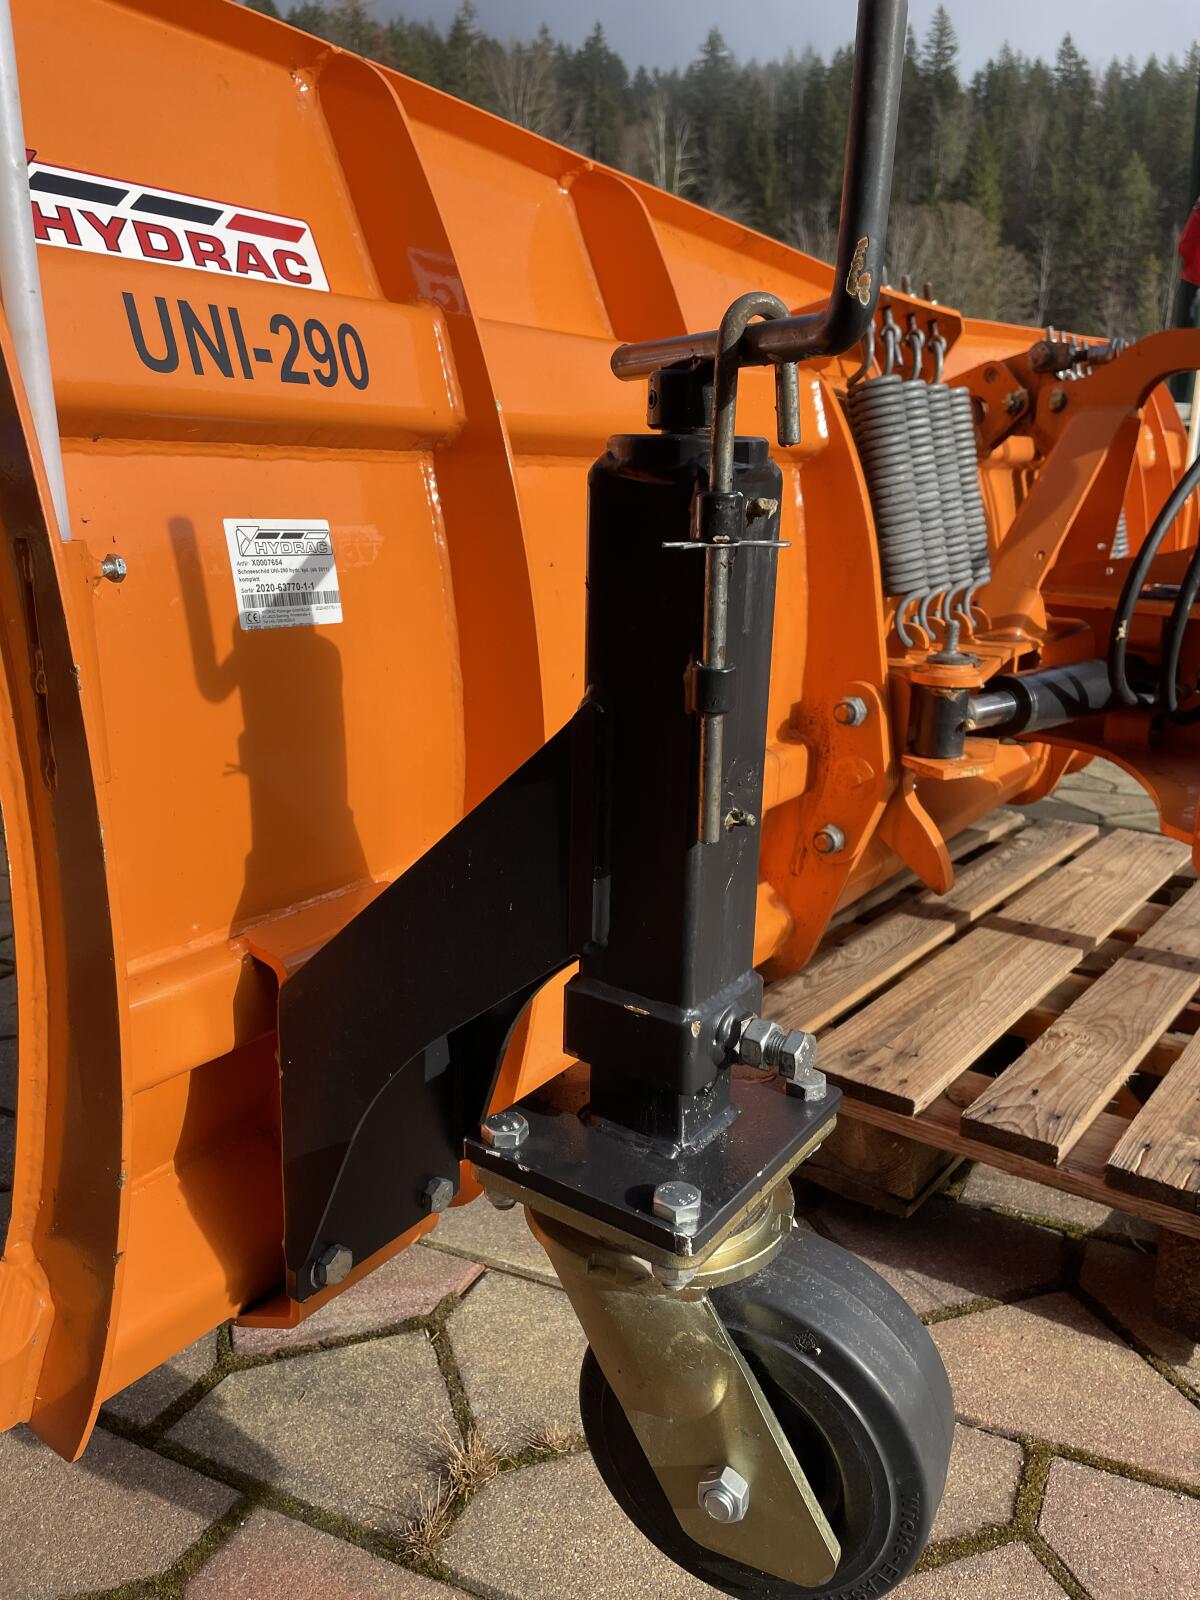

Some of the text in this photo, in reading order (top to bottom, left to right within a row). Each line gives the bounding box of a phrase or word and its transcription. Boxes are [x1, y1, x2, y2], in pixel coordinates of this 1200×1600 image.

[31, 200, 312, 285] HYDRAC
[122, 291, 370, 390] UNI-290
[255, 541, 328, 554] HYDRAC
[251, 559, 283, 567] X0007654
[256, 582, 315, 593] 2020-63770-1-1
